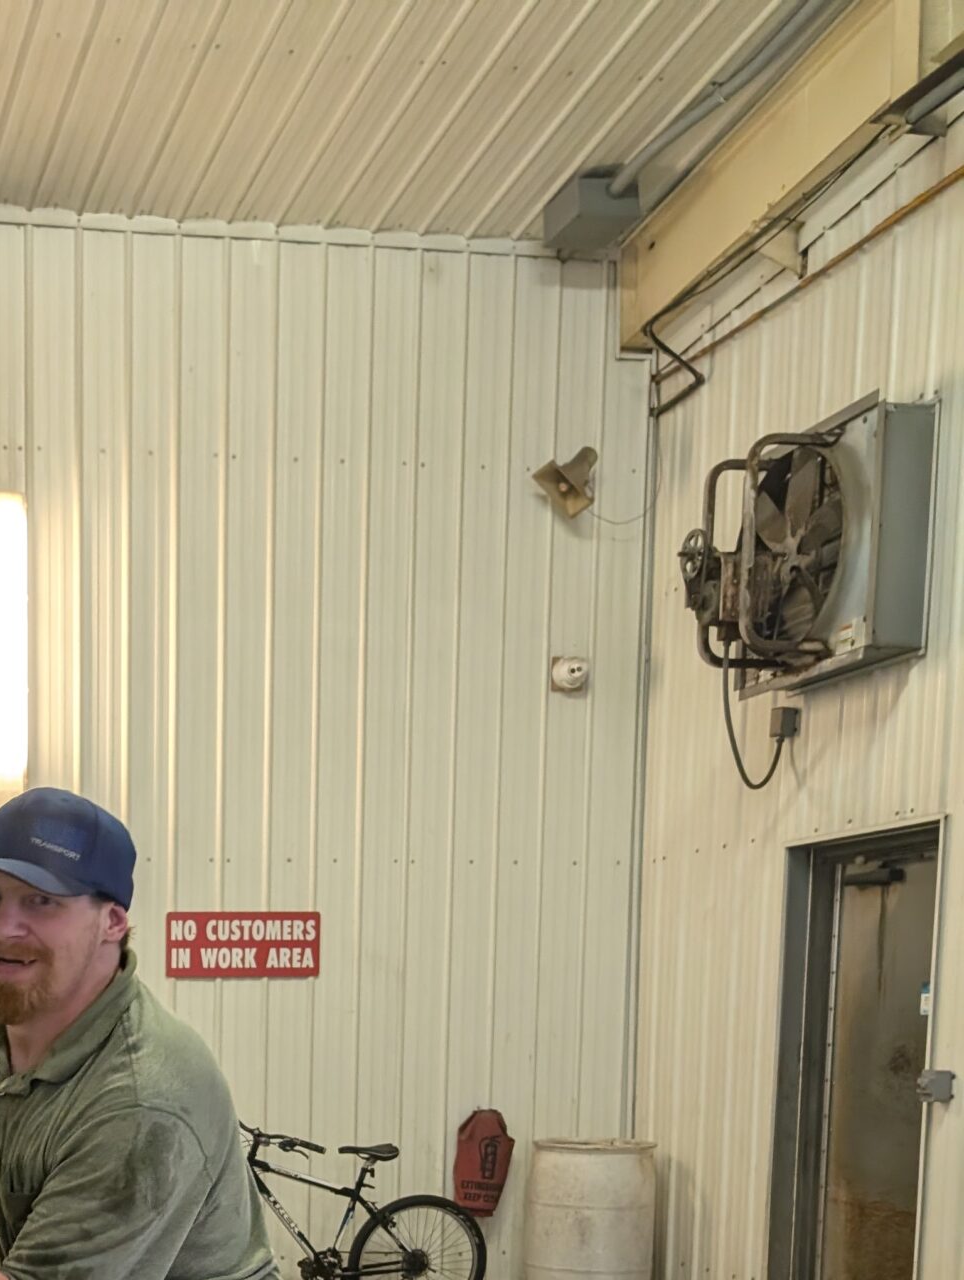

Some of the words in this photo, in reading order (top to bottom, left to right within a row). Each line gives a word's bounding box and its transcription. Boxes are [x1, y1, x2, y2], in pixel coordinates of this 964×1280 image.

[30, 836, 82, 861] TRANSPORT
[170, 919, 198, 942] NO
[205, 919, 317, 942] CUSTOMERS
[170, 947, 191, 969] IN
[200, 947, 258, 969] WORK
[265, 947, 315, 969] AREA
